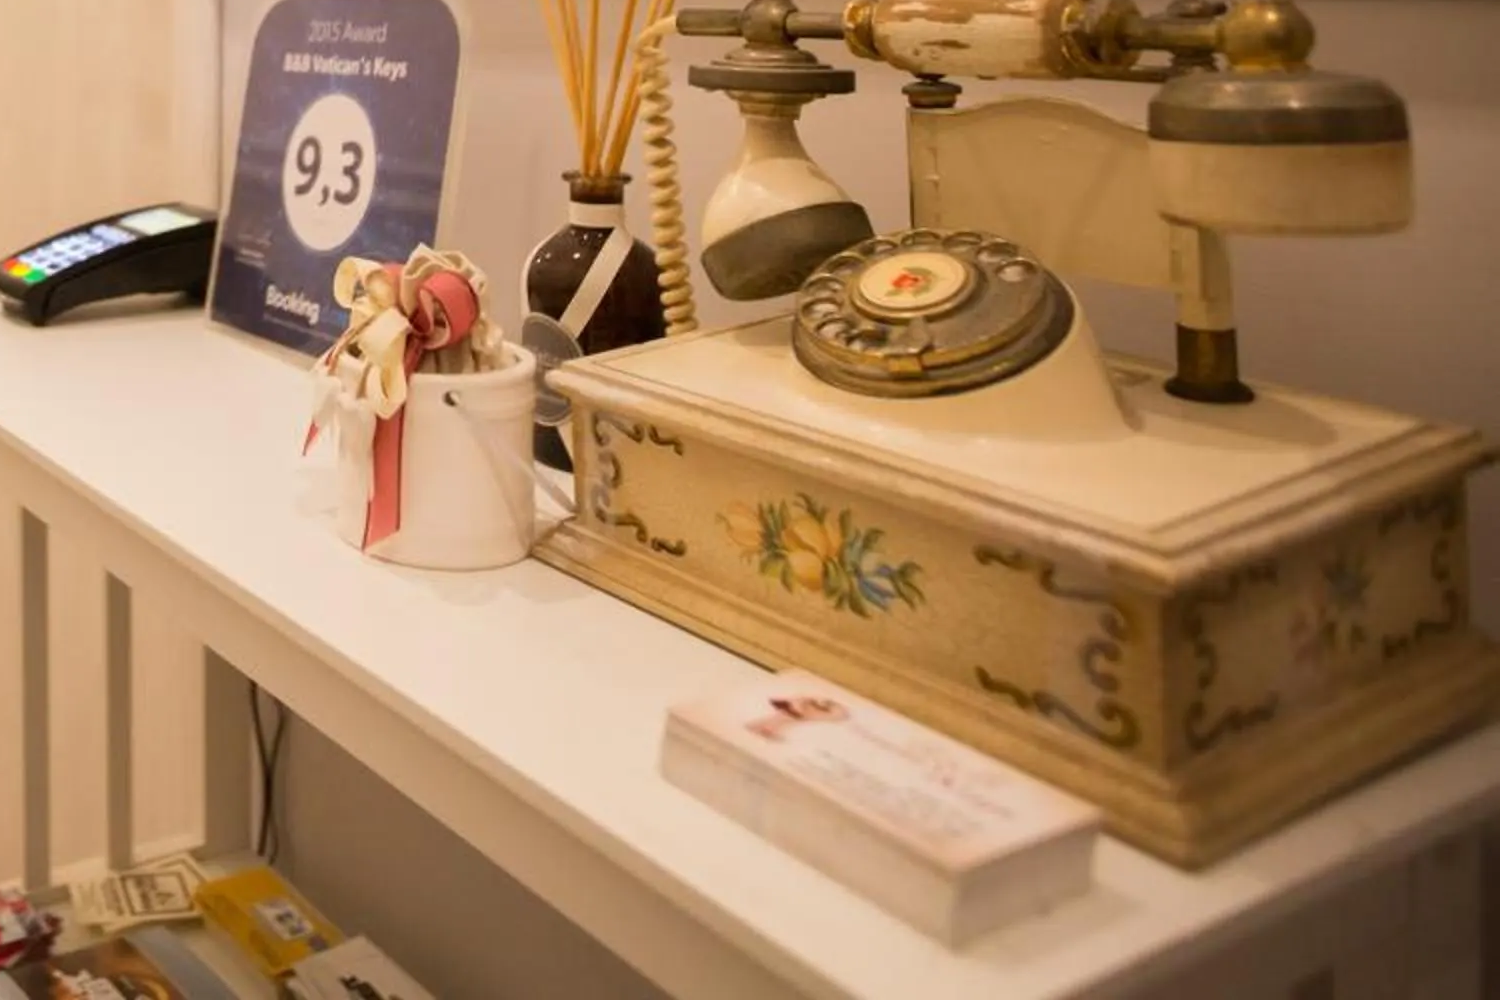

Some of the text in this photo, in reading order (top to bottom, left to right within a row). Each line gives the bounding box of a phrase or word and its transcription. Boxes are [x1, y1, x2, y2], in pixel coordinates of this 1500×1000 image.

[307, 19, 388, 44] 2015 Award
[283, 52, 408, 81] B&B Vatican's Keys
[294, 135, 365, 207] 9,3
